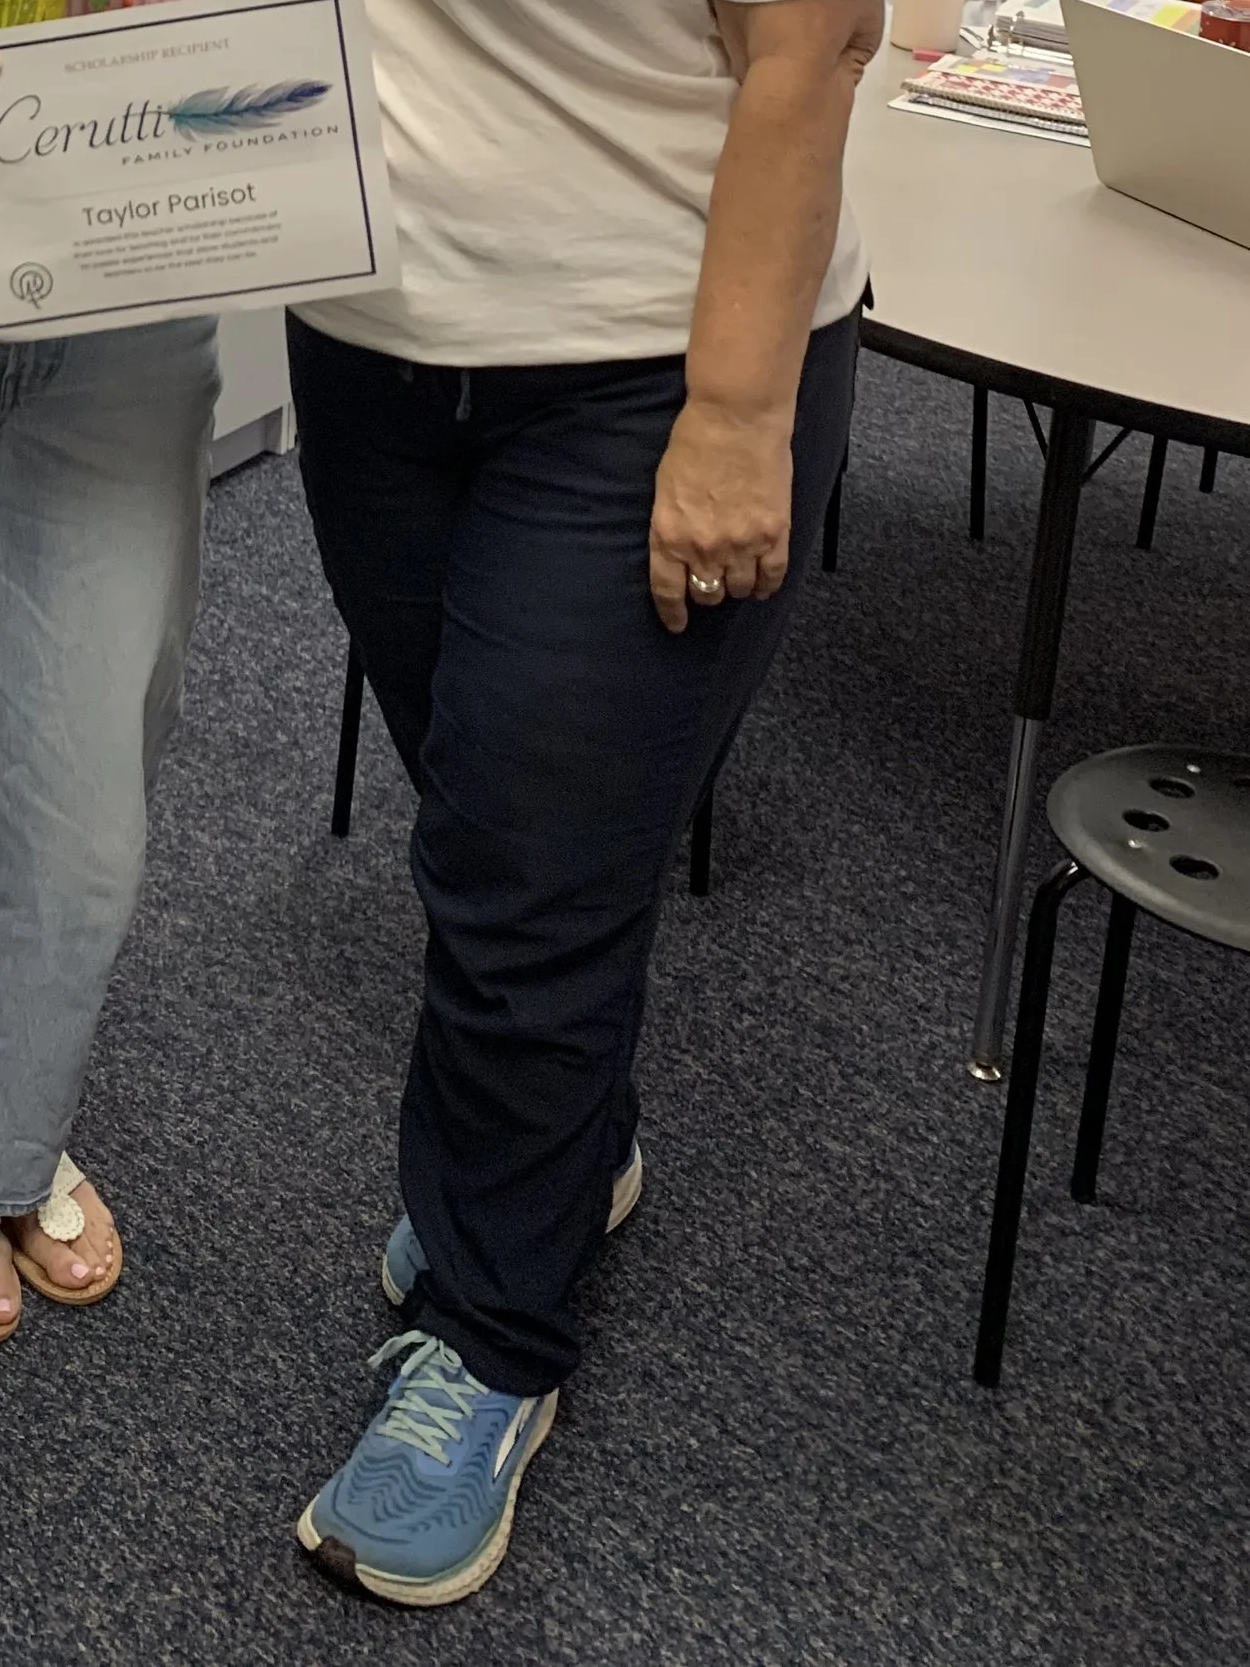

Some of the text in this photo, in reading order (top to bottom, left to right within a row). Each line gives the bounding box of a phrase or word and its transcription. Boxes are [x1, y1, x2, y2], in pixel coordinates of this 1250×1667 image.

[64, 38, 231, 73] SCHOLARSHIP RECIPIENT
[122, 125, 339, 166] FAMILY FOUNDATION
[82, 200, 160, 229] Taylor
[168, 183, 257, 214] Parisot
